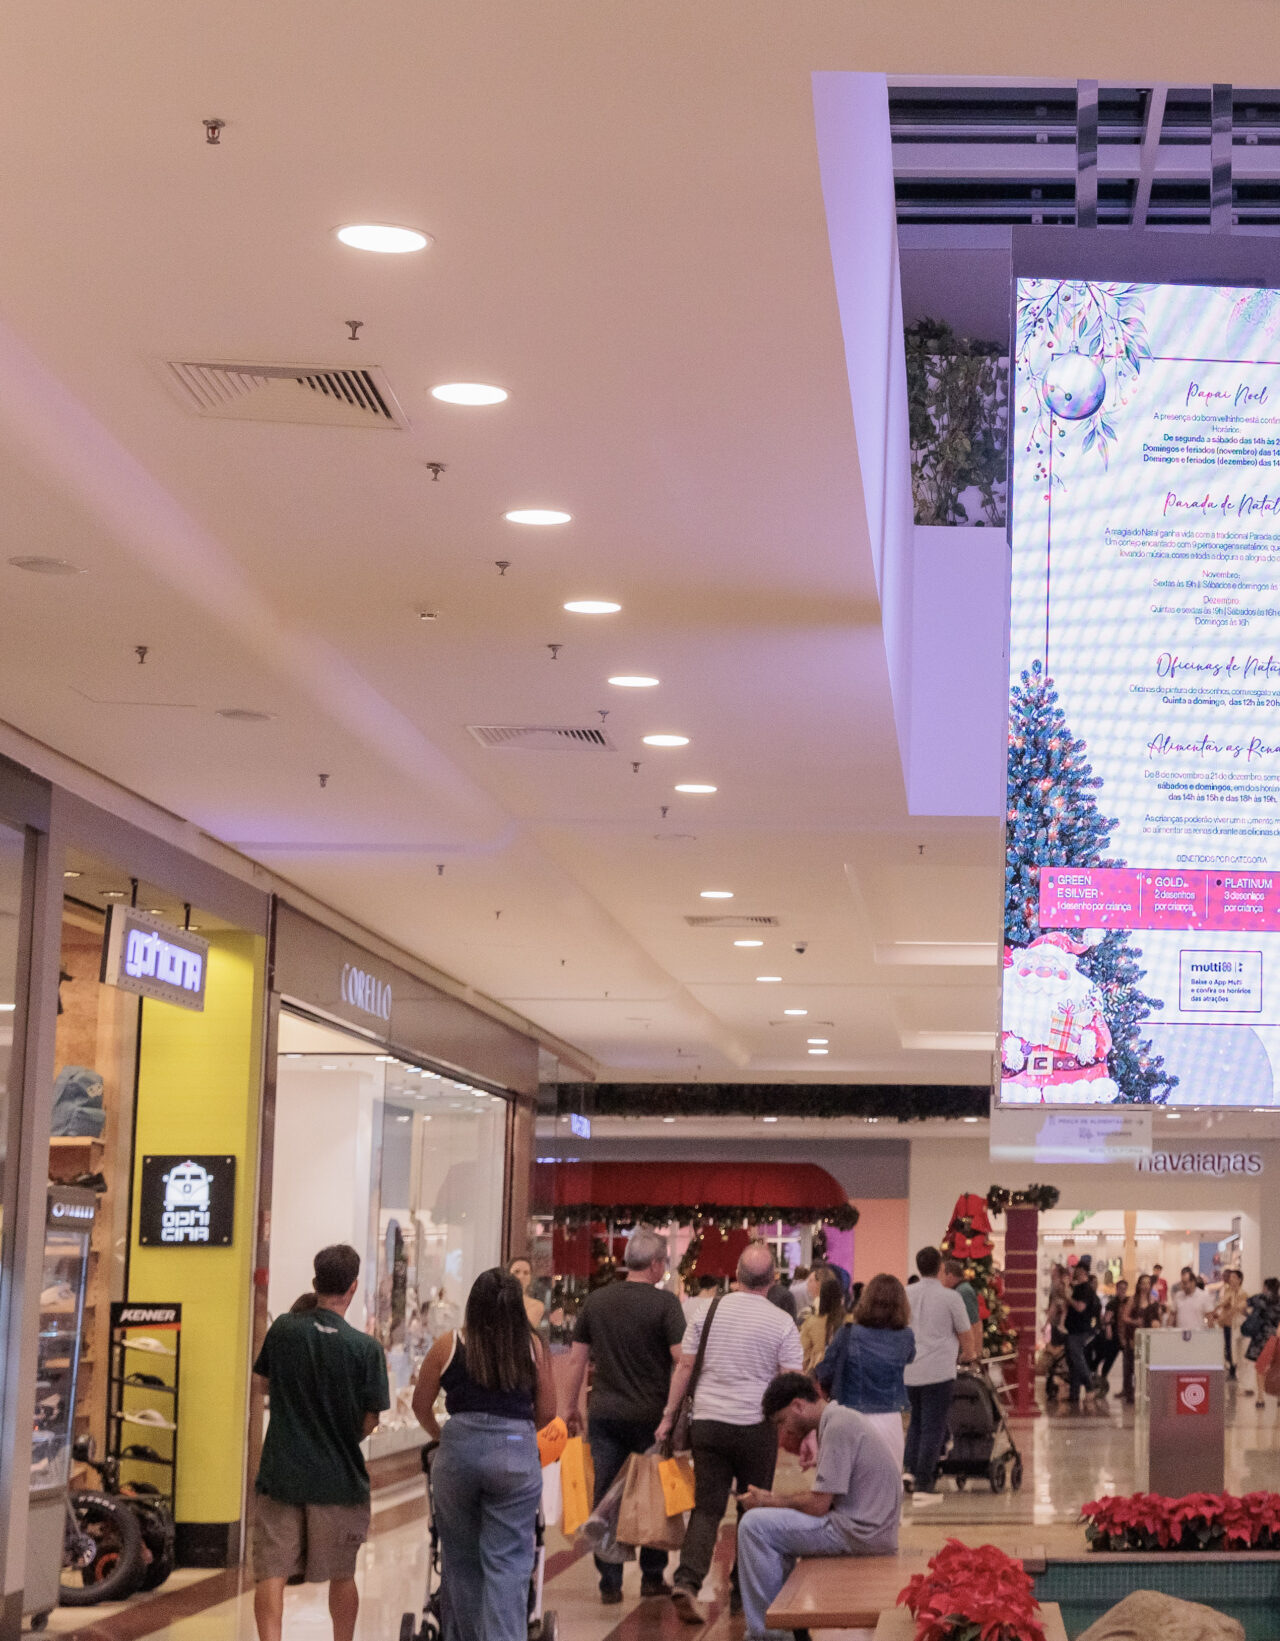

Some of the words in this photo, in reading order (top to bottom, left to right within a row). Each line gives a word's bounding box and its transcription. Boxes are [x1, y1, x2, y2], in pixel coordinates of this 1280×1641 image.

[1186, 381, 1231, 407] Papai
[1234, 383, 1268, 407] Noel
[1153, 412, 1160, 420] A
[1163, 433, 1174, 441] De
[1175, 434, 1205, 443] segunda
[1212, 435, 1238, 443] sábado
[1239, 436, 1252, 444] das
[1253, 437, 1265, 445] 14h
[1143, 443, 1180, 454] Domingos
[1186, 445, 1215, 454] feriados
[1216, 446, 1258, 457] (novembro)
[1259, 447, 1271, 456] das
[1143, 454, 1180, 464] Domingos
[1186, 456, 1215, 464] feriados
[1217, 456, 1258, 467] (dezembro)
[1258, 458, 1271, 466] das
[1163, 491, 1218, 516] Parada
[1221, 494, 1235, 516] de
[1157, 652, 1223, 678] Oficinas
[1226, 655, 1240, 678] de
[1162, 695, 1186, 704] Quinta
[1193, 696, 1226, 707] domingo,
[1228, 697, 1242, 706] das
[1243, 698, 1255, 706] 12h
[1265, 698, 1280, 707] 20h
[1147, 733, 1223, 760] Alimentar
[1226, 745, 1244, 758] as
[1157, 781, 1188, 790] sábados
[1057, 875, 1092, 886] GREEN
[1154, 876, 1184, 887] GOLD
[1224, 878, 1273, 889] PLATINUM
[1057, 888, 1064, 898] E
[1065, 888, 1098, 899] SILVER
[1154, 890, 1161, 899] 2
[1161, 890, 1195, 899] desenhos
[1224, 891, 1229, 900] 3
[1061, 901, 1092, 911] desenho
[1092, 903, 1105, 913] por
[1105, 902, 1132, 913] criança
[1154, 902, 1167, 912] por
[1167, 902, 1194, 913] criança
[1224, 904, 1237, 914] por
[1237, 903, 1263, 914] criança
[1191, 961, 1221, 972] multi
[341, 962, 392, 1021] CORELLO
[119, 1309, 176, 1323] KENNER
